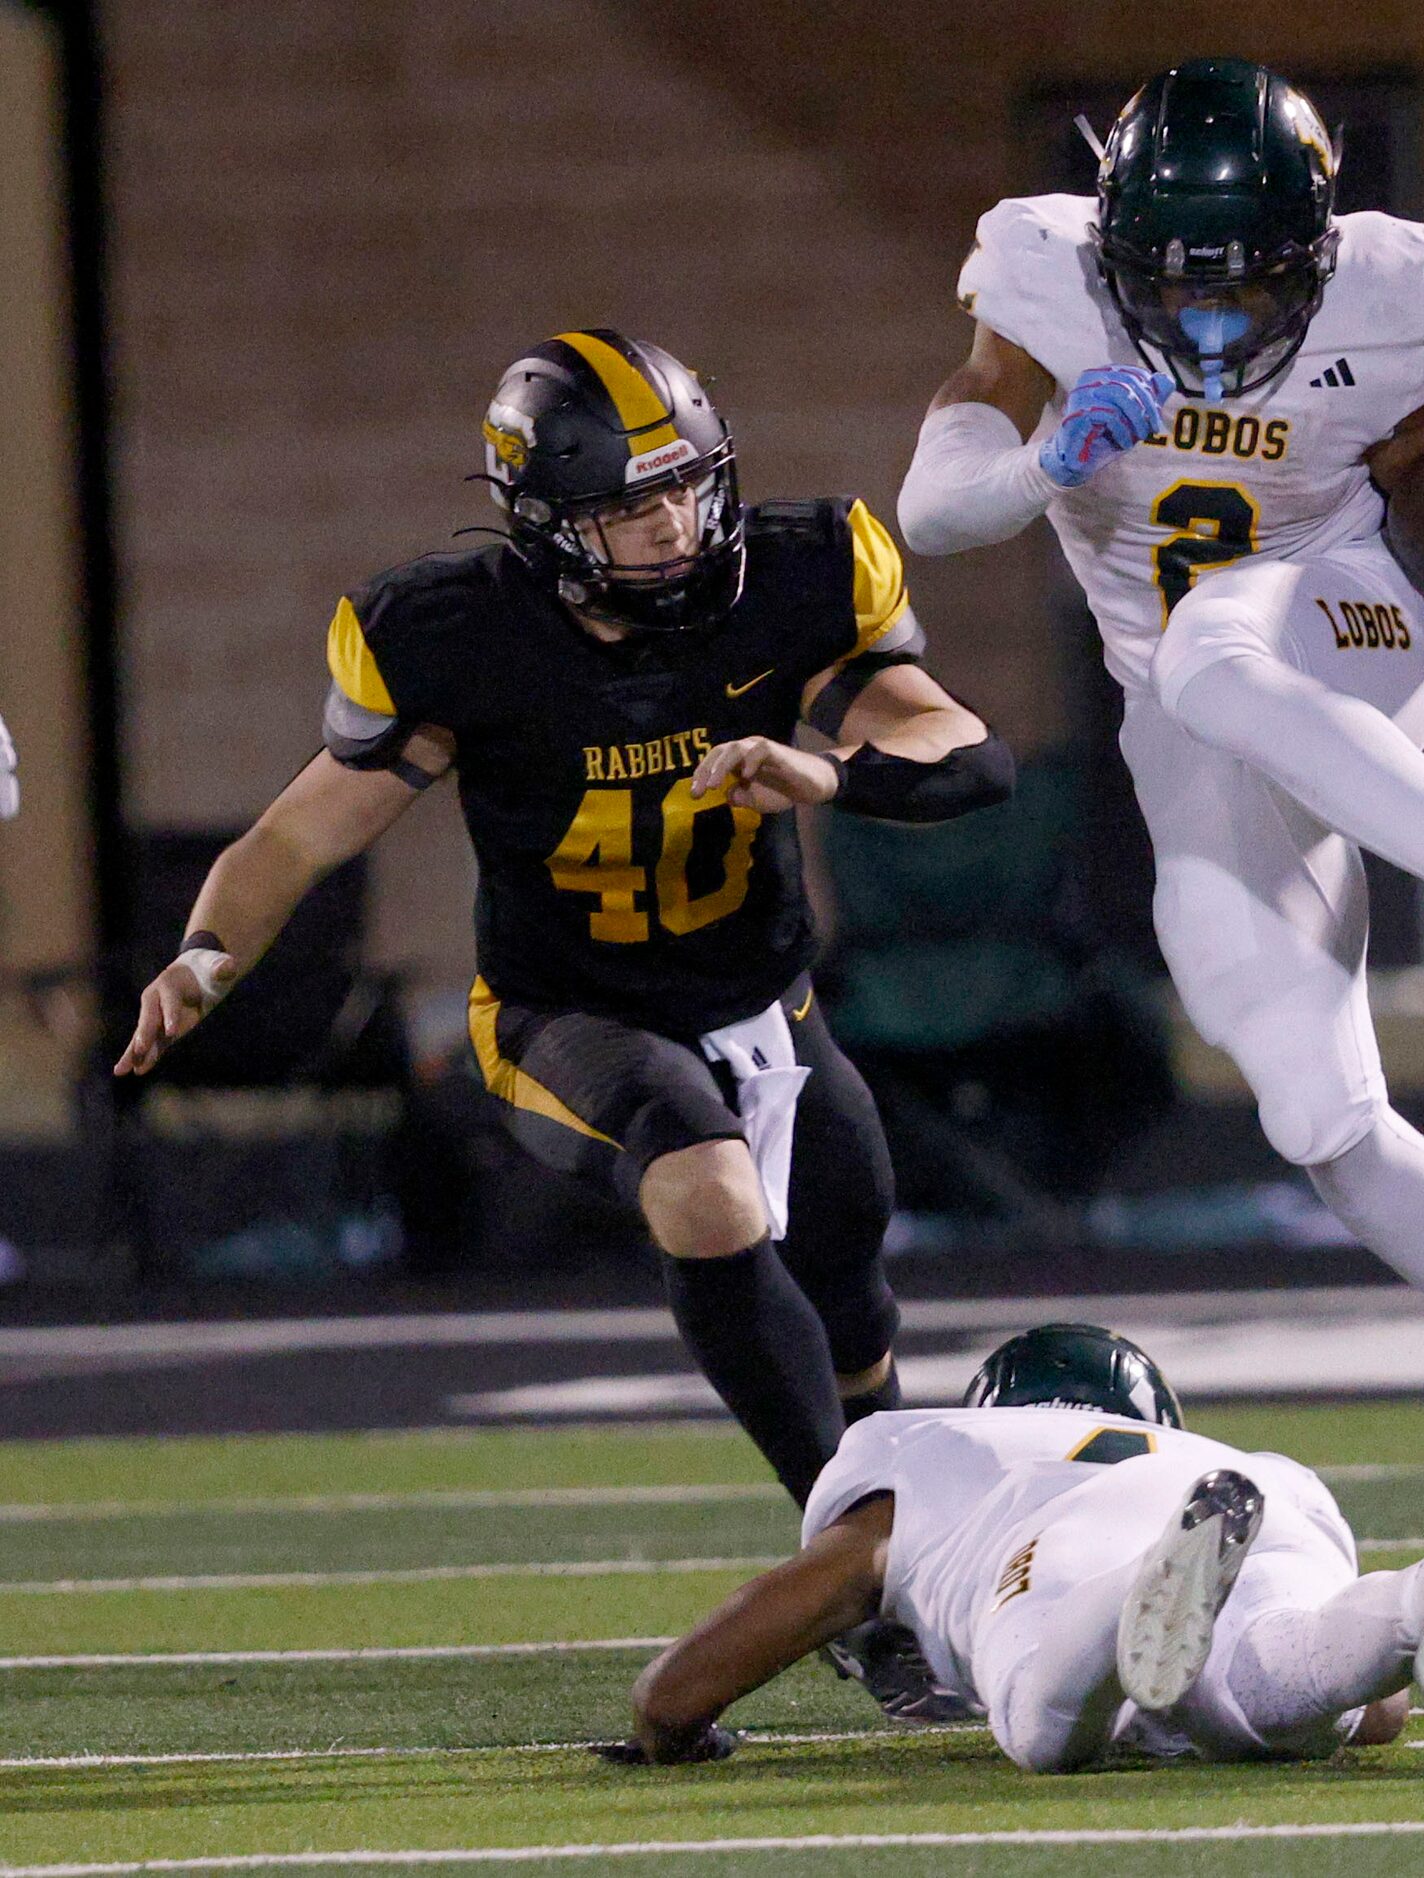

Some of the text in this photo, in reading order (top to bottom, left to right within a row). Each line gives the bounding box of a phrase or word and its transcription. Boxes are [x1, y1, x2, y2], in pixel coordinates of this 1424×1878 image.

[636, 444, 689, 474] Riddell
[1151, 477, 1260, 632] 2
[1315, 598, 1411, 650] LOBOS
[583, 727, 712, 781] RABBITS
[543, 773, 762, 944] 40
